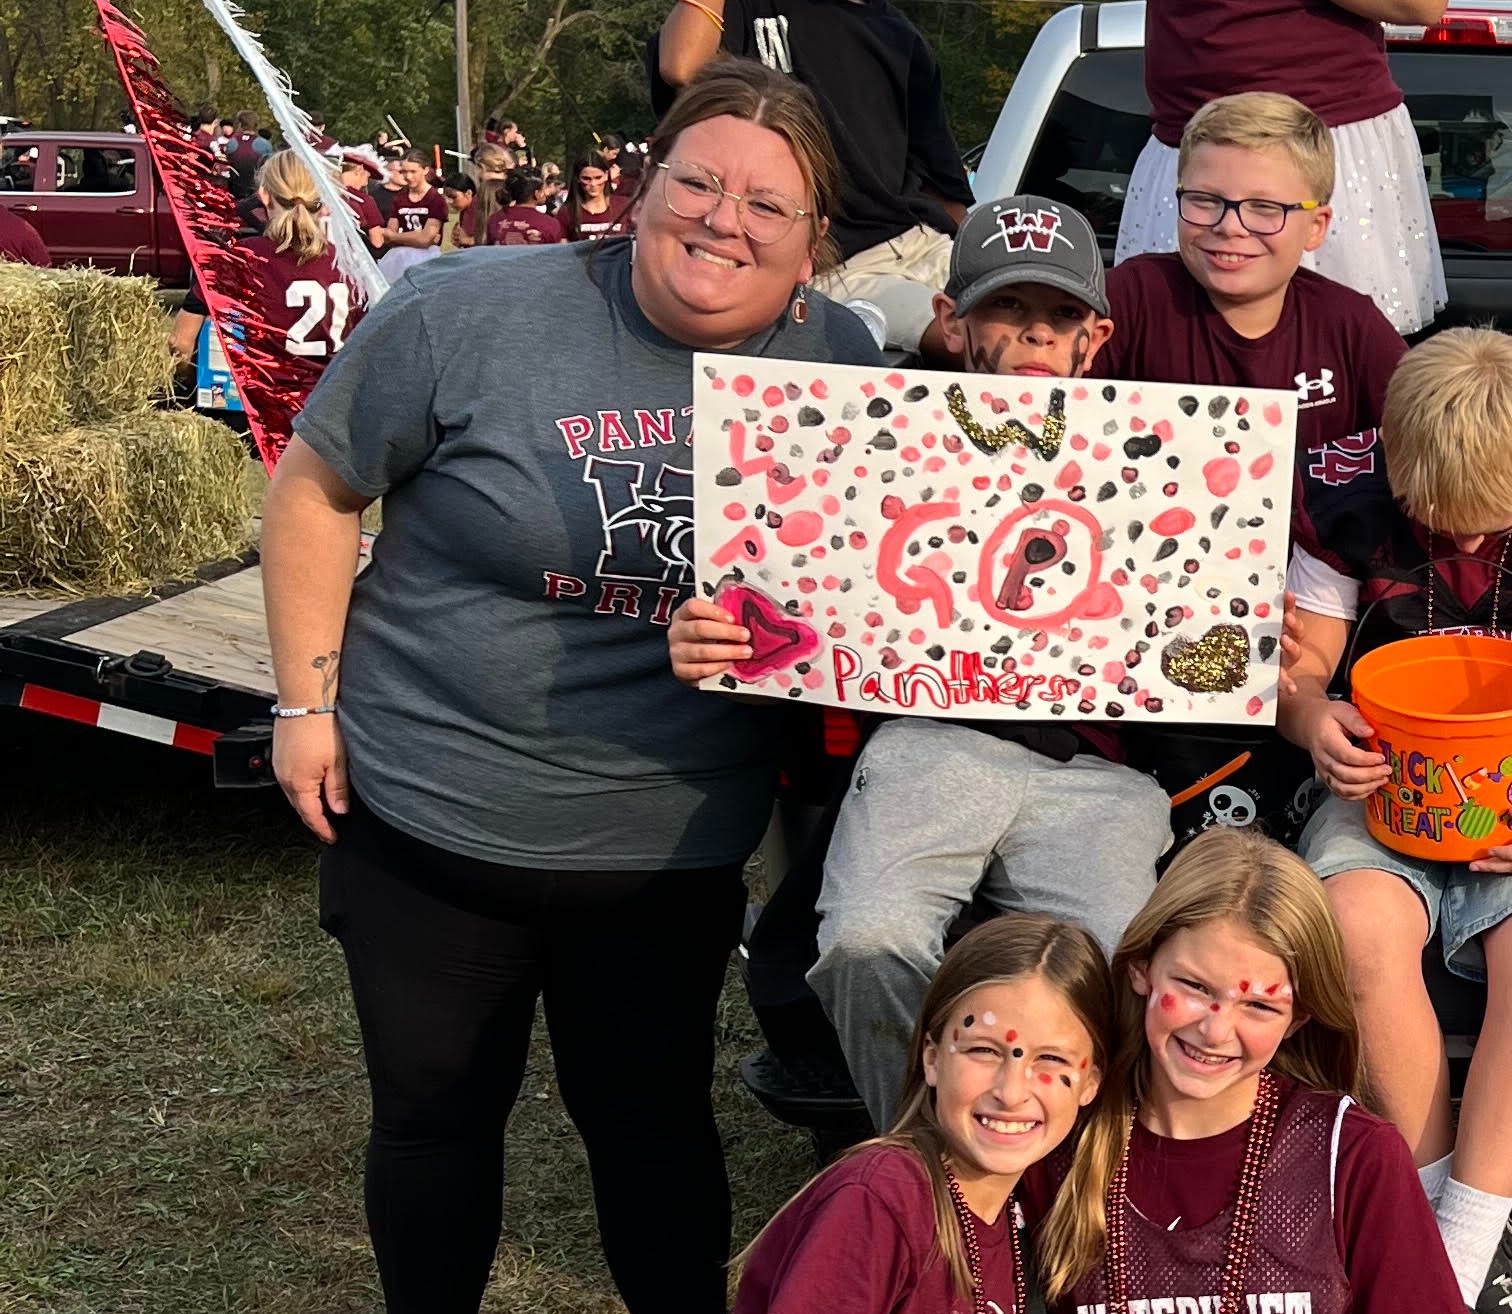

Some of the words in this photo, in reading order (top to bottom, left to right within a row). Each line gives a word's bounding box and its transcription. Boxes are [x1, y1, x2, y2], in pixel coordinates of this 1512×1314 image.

[996, 208, 1062, 254] W
[285, 280, 349, 357] 21
[943, 381, 1067, 462] W
[876, 498, 1105, 634] GO
[543, 570, 695, 626] PRI
[833, 644, 1076, 710] Panthers
[1377, 739, 1445, 795] TRICK
[1377, 786, 1452, 843] TREAT
[1398, 787, 1424, 808] OR
